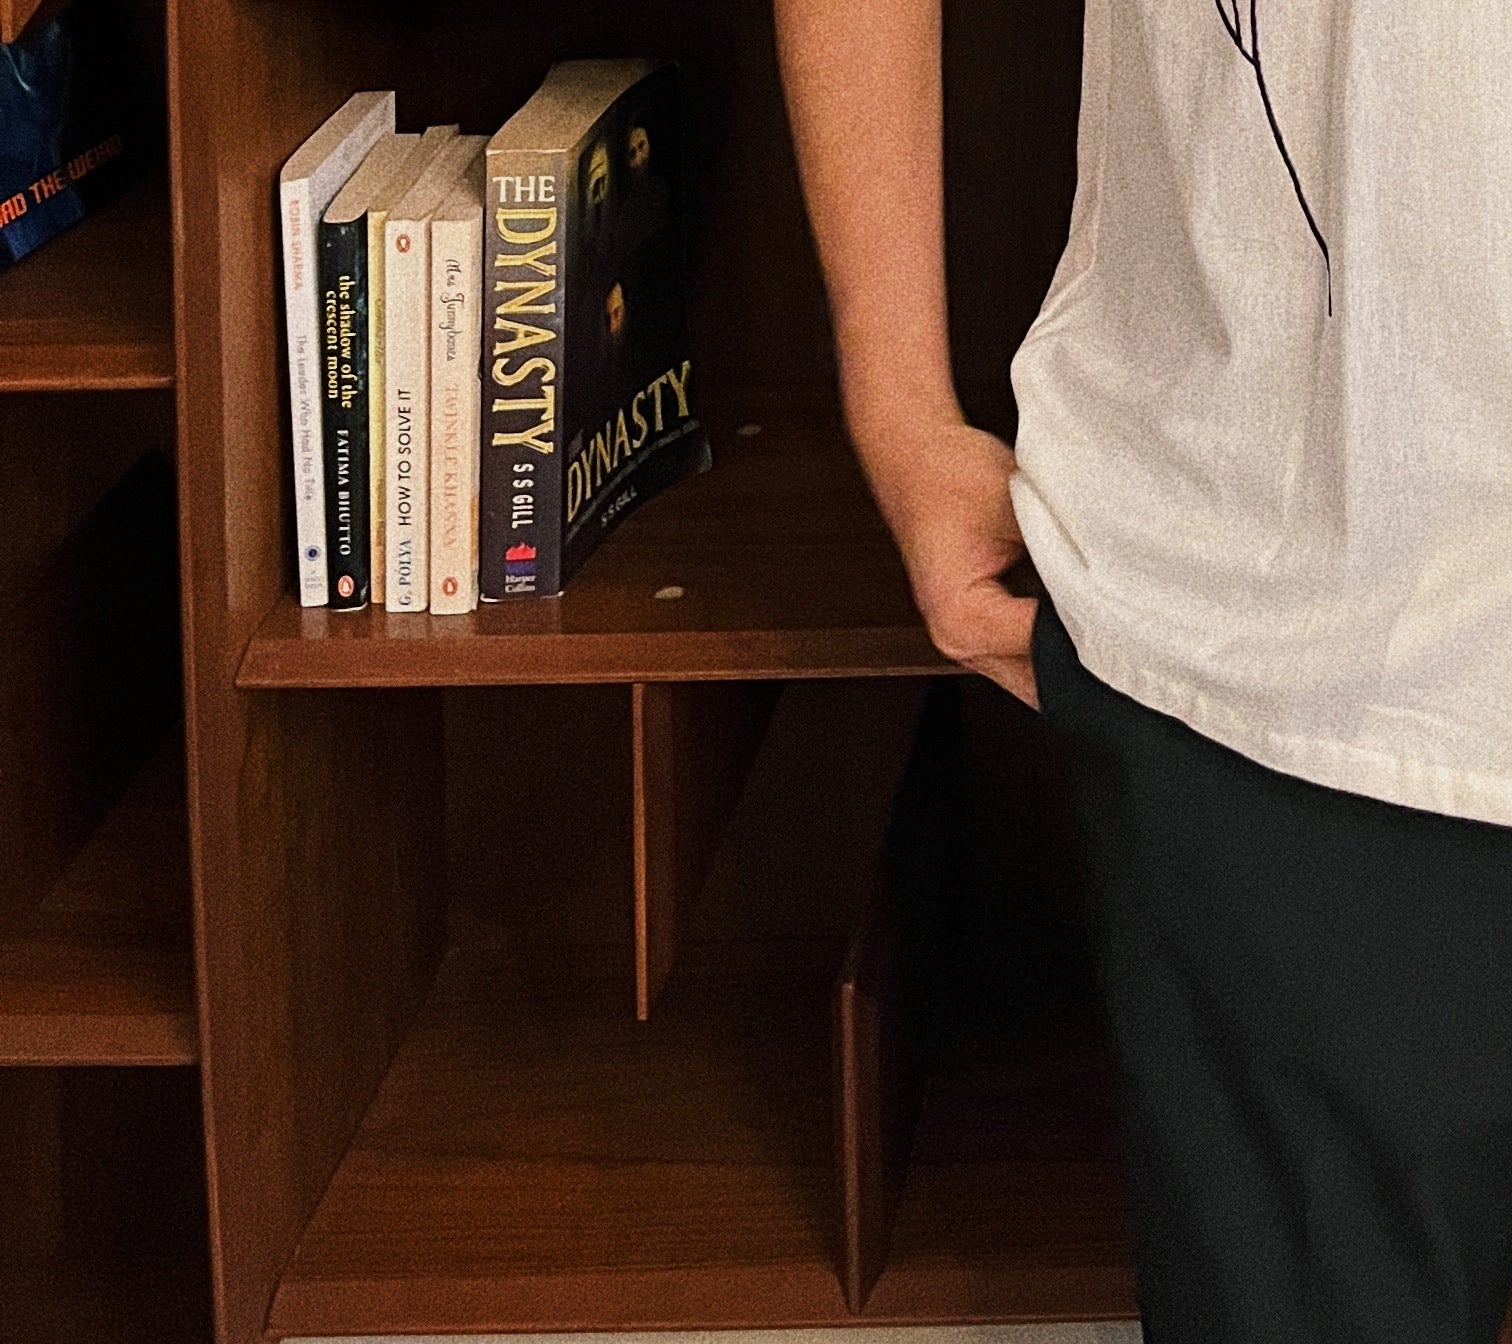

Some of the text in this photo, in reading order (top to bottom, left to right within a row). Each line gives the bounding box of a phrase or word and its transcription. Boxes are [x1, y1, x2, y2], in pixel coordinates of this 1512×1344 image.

[28, 170, 66, 204] THE
[492, 176, 555, 203] THE
[491, 207, 557, 454] DYNASTY
[398, 390, 411, 527] HOW TO SOLVE IT
[567, 361, 690, 523] DYNASTY
[400, 540, 412, 593] POLYA
